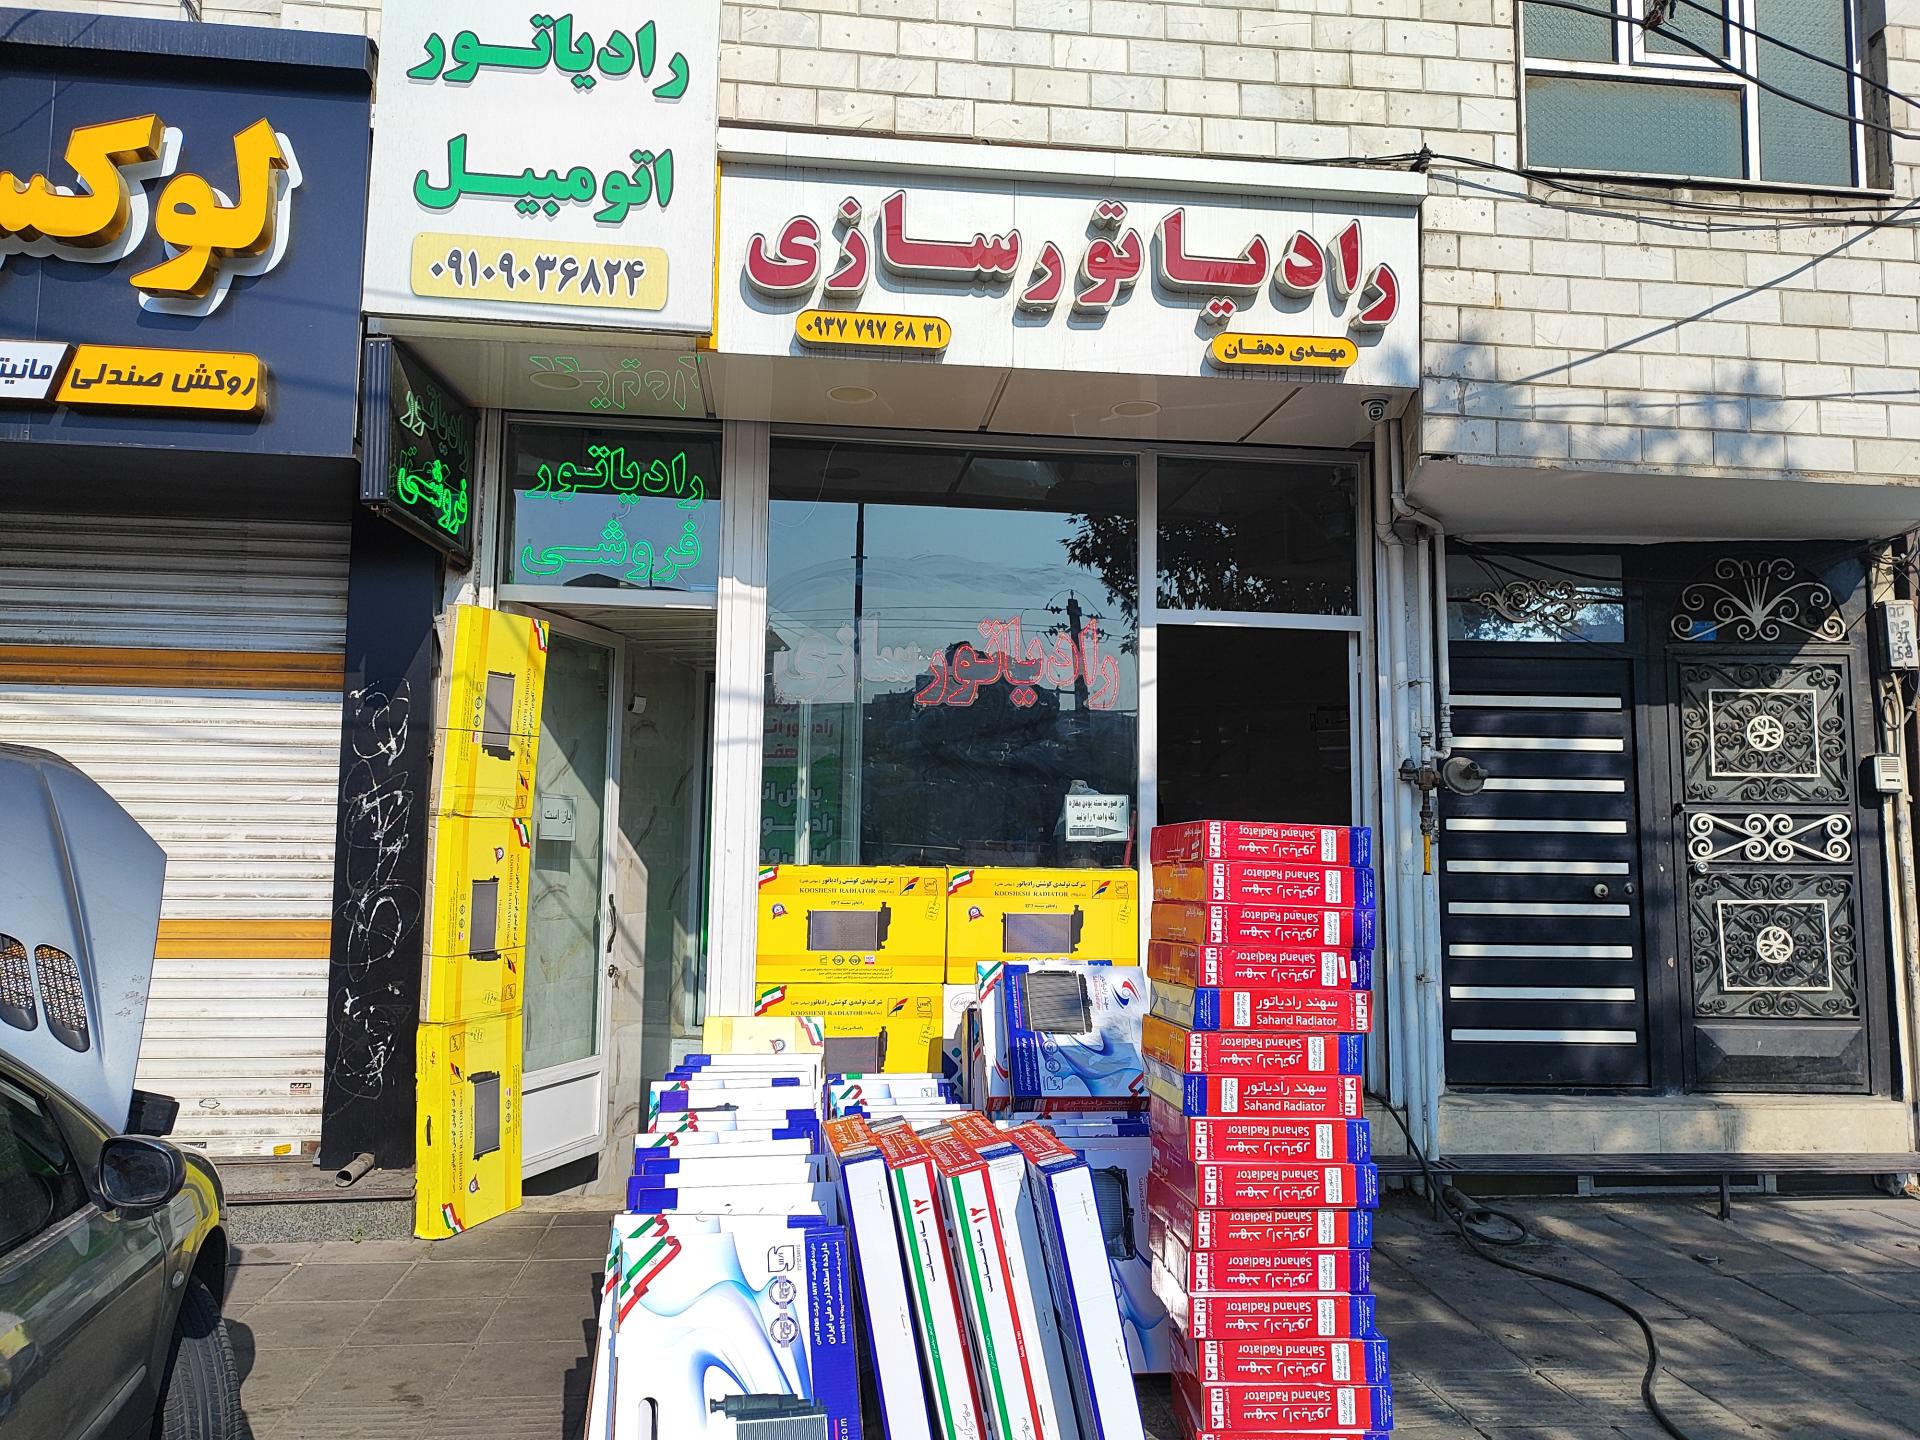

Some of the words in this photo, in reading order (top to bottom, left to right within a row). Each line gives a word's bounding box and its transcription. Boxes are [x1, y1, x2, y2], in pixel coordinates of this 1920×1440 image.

[406, 13, 690, 99] رادیاتور
[413, 133, 674, 223] اتومبیل
[431, 249, 645, 296] ۰۹۱۰۹۰۳۶۸۲۴
[1224, 338, 1285, 359] دهقان
[1289, 344, 1346, 362] مهدی
[70, 364, 164, 390] صندلی
[171, 364, 256, 396] روکش
[524, 445, 704, 509] رادیاتور
[521, 519, 702, 581] فروشی
[544, 809, 560, 820] است
[561, 809, 572, 824] باز
[1239, 825, 1278, 838] Radiator
[1281, 828, 1315, 840] Sahand
[1243, 869, 1282, 879] Radiator
[1285, 871, 1319, 880] Sahand
[1241, 911, 1280, 921] Radiator
[1284, 912, 1318, 922] Sahand
[1236, 951, 1276, 962] Radiator
[1280, 952, 1315, 964] Sahand
[1257, 1015, 1293, 1024] Sahand
[1296, 1016, 1337, 1026] Radiator
[1220, 1038, 1262, 1048] Radiator
[1266, 1039, 1301, 1048] Sahand
[1244, 1100, 1281, 1110] Sahand
[1284, 1101, 1325, 1111] Radiator
[1228, 1126, 1269, 1136] Radiator
[1272, 1126, 1309, 1136] Sahand
[1237, 1170, 1278, 1181] Radiator
[1282, 1170, 1318, 1180] Sahand
[1230, 1212, 1272, 1222] Radiator
[1275, 1212, 1312, 1222] Sahand
[1228, 1257, 1271, 1267] Radiator
[1274, 1257, 1312, 1267] Sahand
[1227, 1302, 1270, 1313] Radiator
[1273, 1302, 1311, 1313] Sahand
[1238, 1345, 1282, 1356] Radiator
[1286, 1346, 1324, 1356] Sahand
[1244, 1392, 1288, 1402] Radiator
[1292, 1391, 1331, 1404] Sahand
